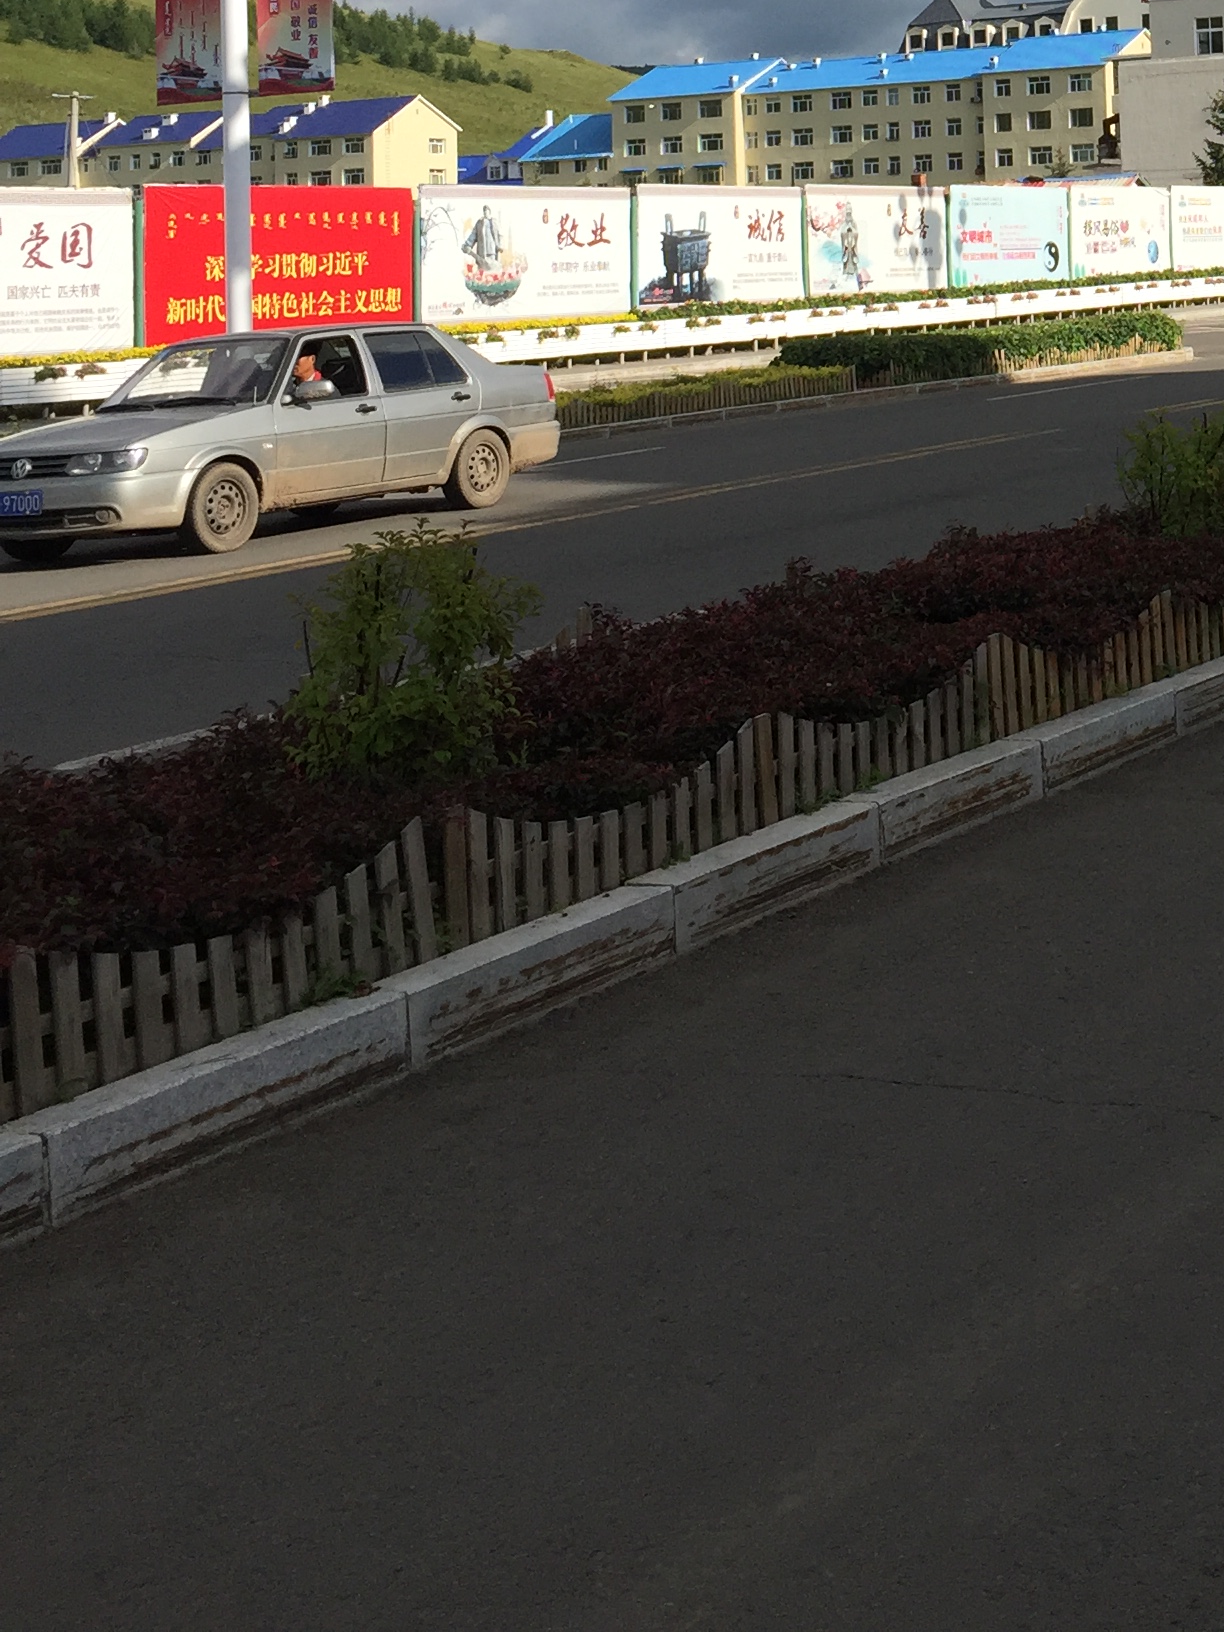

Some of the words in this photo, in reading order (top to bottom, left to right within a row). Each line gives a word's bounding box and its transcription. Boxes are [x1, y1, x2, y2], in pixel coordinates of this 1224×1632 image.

[557, 213, 611, 250] 敬业
[747, 208, 785, 242] 诚信
[20, 222, 93, 268] 爱国
[205, 250, 369, 282] 深学习贯彻习近平
[7, 285, 51, 300] 国家兴亡
[58, 283, 101, 299] 匹夫有责
[166, 287, 402, 325] 新时代国特色社会主义思想
